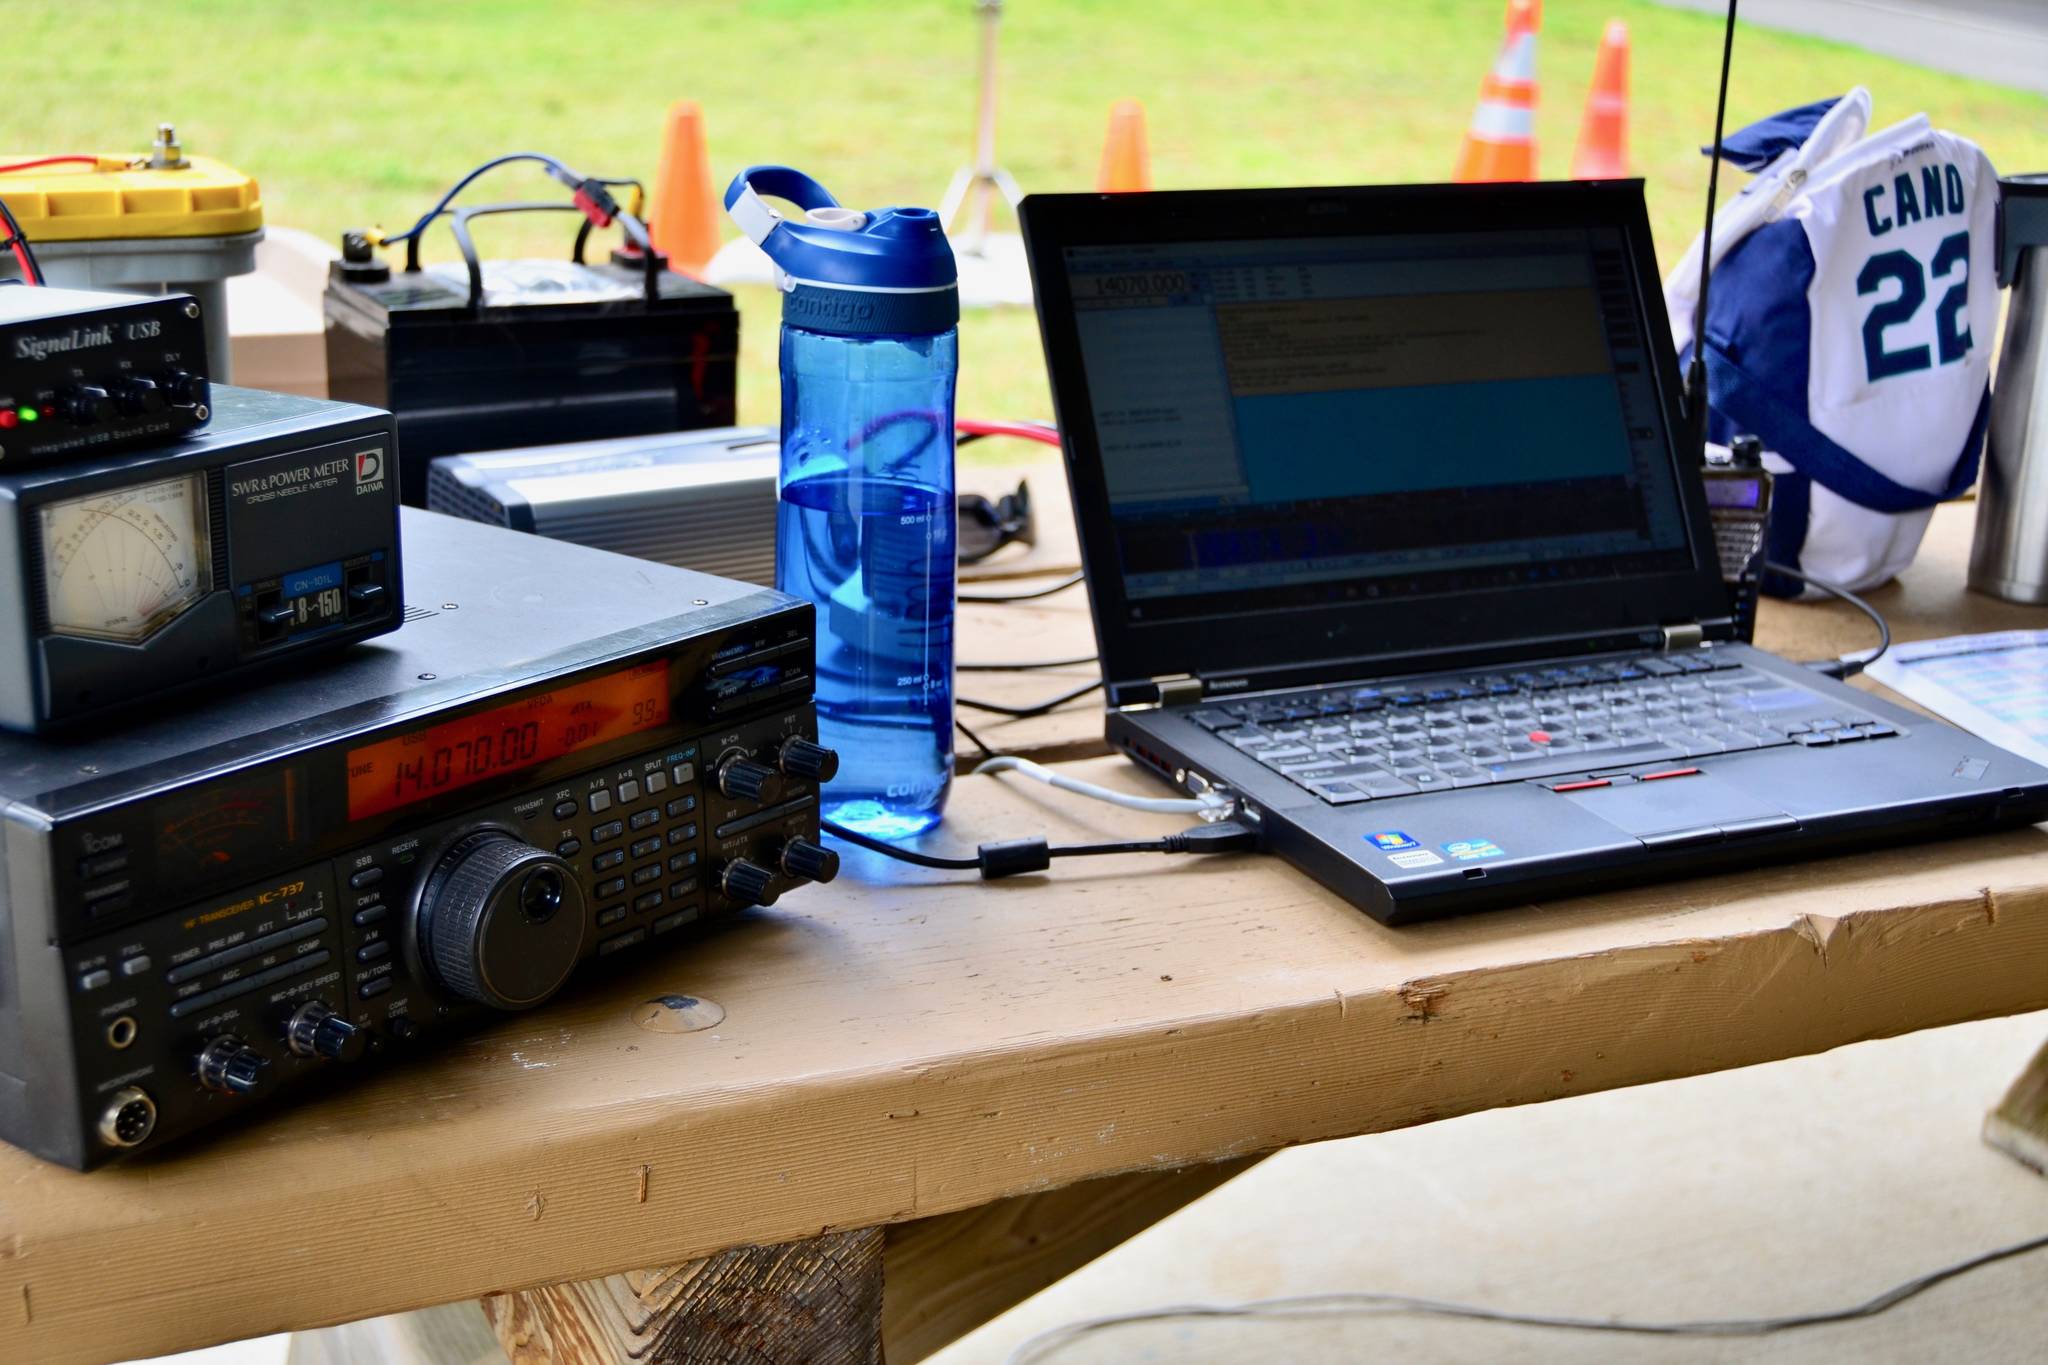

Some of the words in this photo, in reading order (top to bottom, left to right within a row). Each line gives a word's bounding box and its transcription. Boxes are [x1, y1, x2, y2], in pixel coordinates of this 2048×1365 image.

[1863, 163, 1965, 236] CANO
[1857, 231, 1973, 383] 22
[15, 323, 113, 361] SignaLink
[128, 320, 161, 340] USB
[314, 459, 350, 478] METER
[246, 491, 276, 505] CROSS
[278, 485, 308, 498] NEEDLE
[309, 478, 338, 490] METER
[356, 481, 384, 495] DAIWA
[900, 515, 915, 525] 500
[897, 677, 912, 687] 250
[633, 698, 656, 725] 99
[394, 721, 539, 797] 14.070.00
[590, 779, 605, 790] A/B
[645, 760, 662, 772] SPLIT
[556, 789, 570, 801] XFC
[513, 798, 544, 814] TRANSMIT
[392, 839, 419, 855] RECEIVE
[356, 855, 372, 867] SSB
[258, 881, 305, 905] IC-737
[357, 892, 380, 906] CW/N
[297, 908, 313, 920] ANT
[172, 947, 200, 962] TUNER
[208, 938, 226, 951] PRE
[227, 931, 245, 944] AMP
[258, 921, 274, 933] ATT
[365, 931, 378, 941] AM
[222, 969, 240, 981] AGC
[297, 939, 320, 954] COMP
[315, 971, 341, 987] SPEED
[356, 961, 392, 980] FM/TONE
